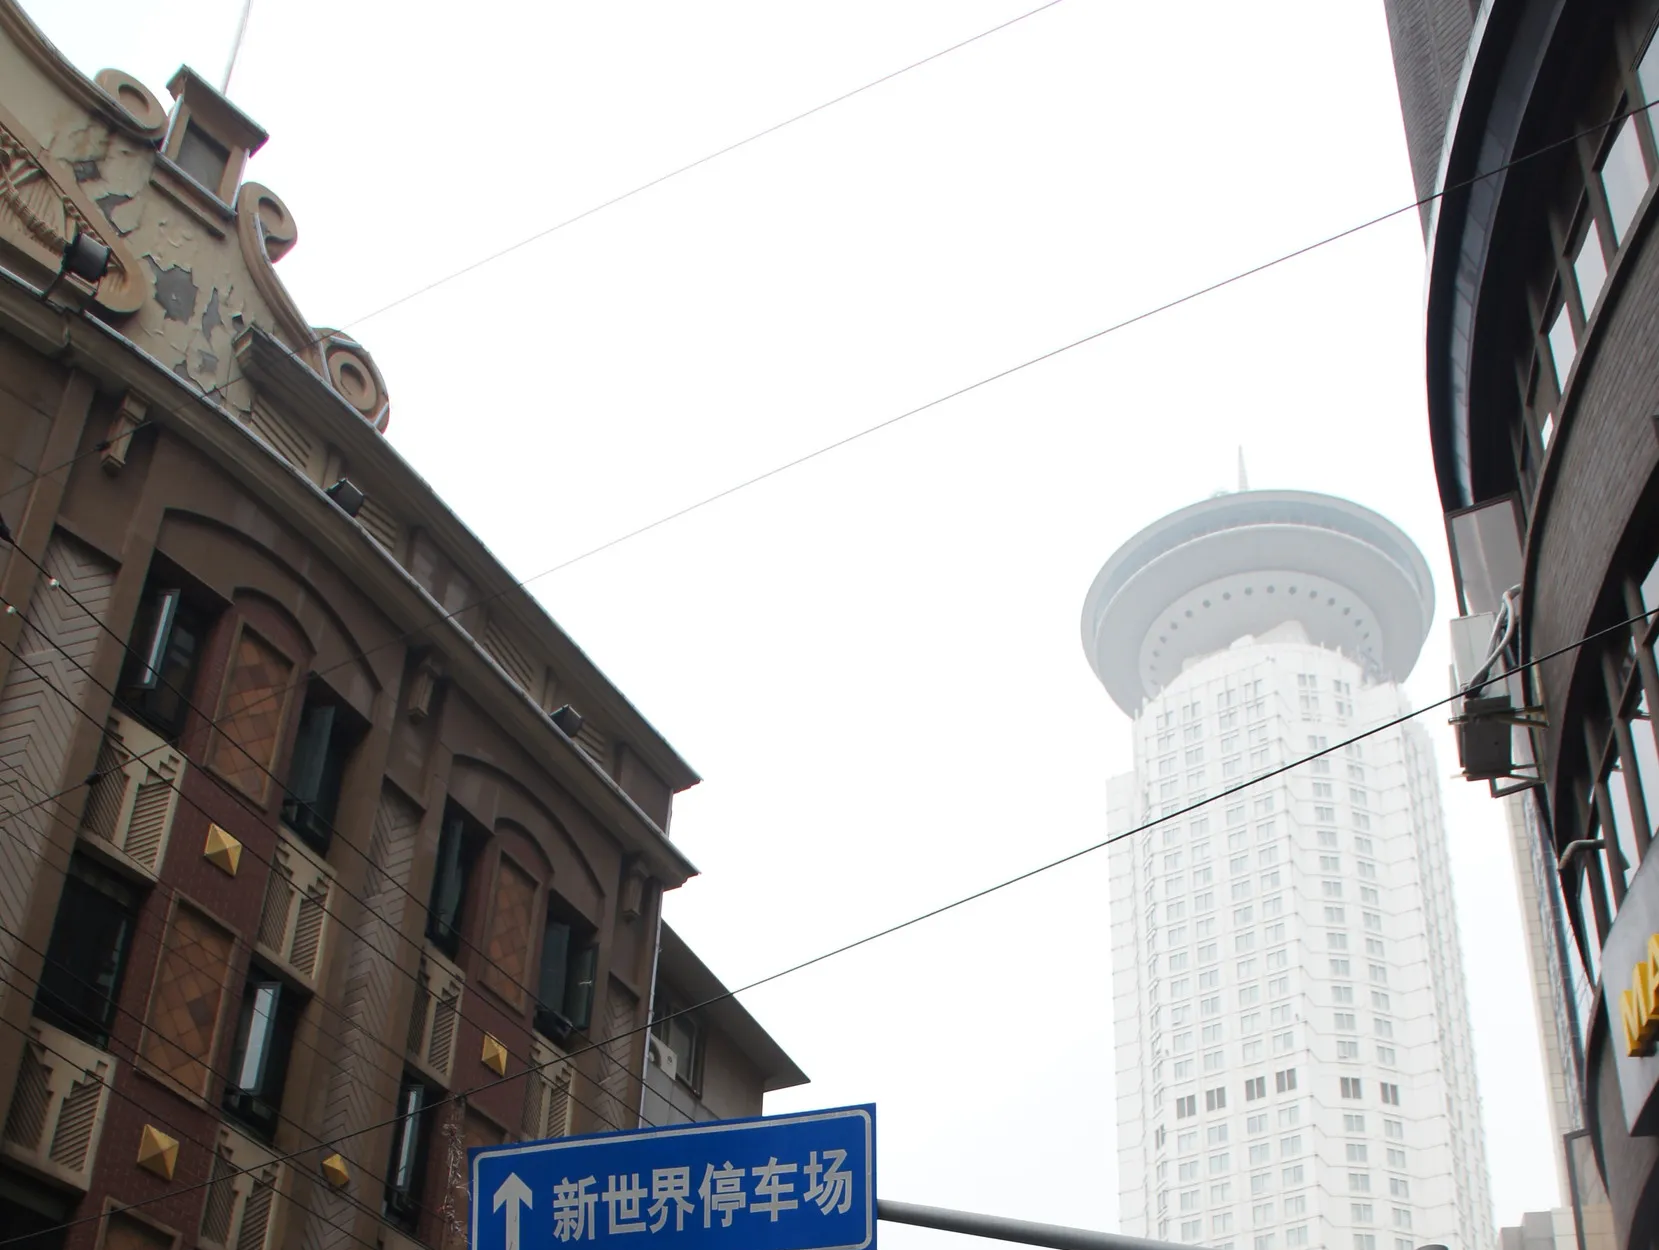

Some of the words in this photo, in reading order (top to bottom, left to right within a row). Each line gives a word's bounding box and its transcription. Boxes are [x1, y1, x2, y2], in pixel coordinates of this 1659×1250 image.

[553, 1149, 852, 1242] 新世界停车场
